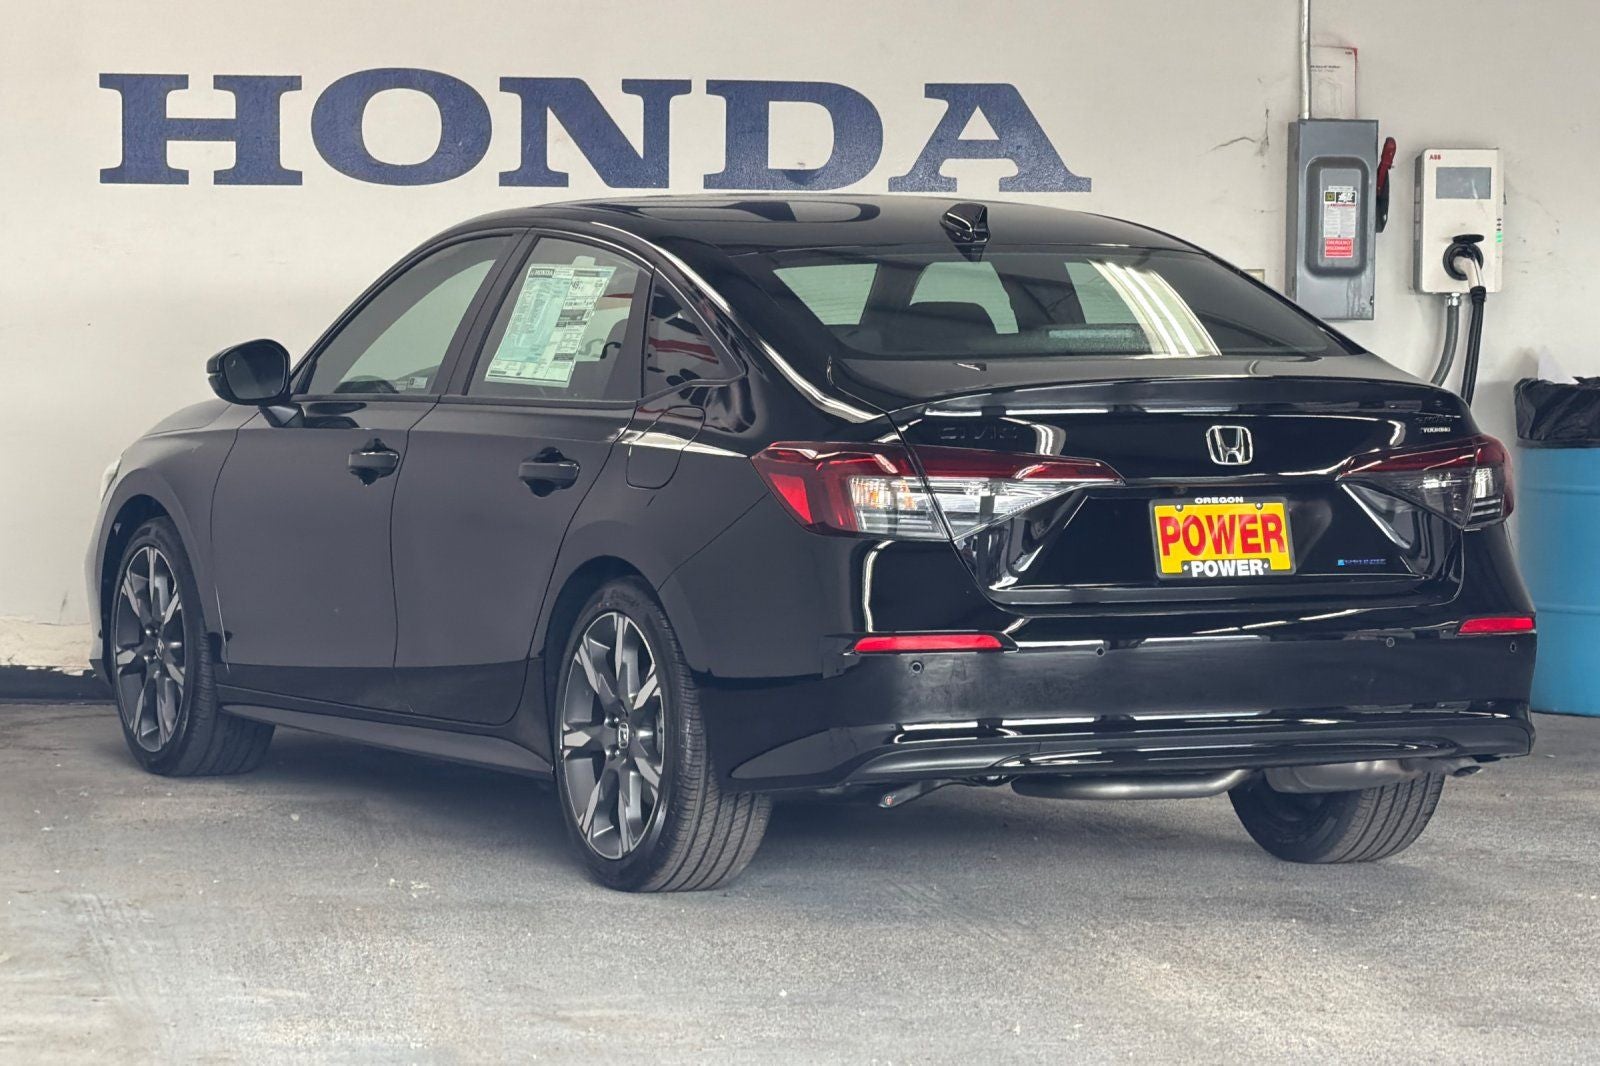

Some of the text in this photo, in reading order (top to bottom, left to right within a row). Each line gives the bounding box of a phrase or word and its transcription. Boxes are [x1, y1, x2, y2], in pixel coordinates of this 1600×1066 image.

[99, 67, 1092, 192] HONDA
[1194, 496, 1244, 504] OREGON
[1158, 513, 1286, 557] POWER
[1191, 560, 1265, 577] POWER
